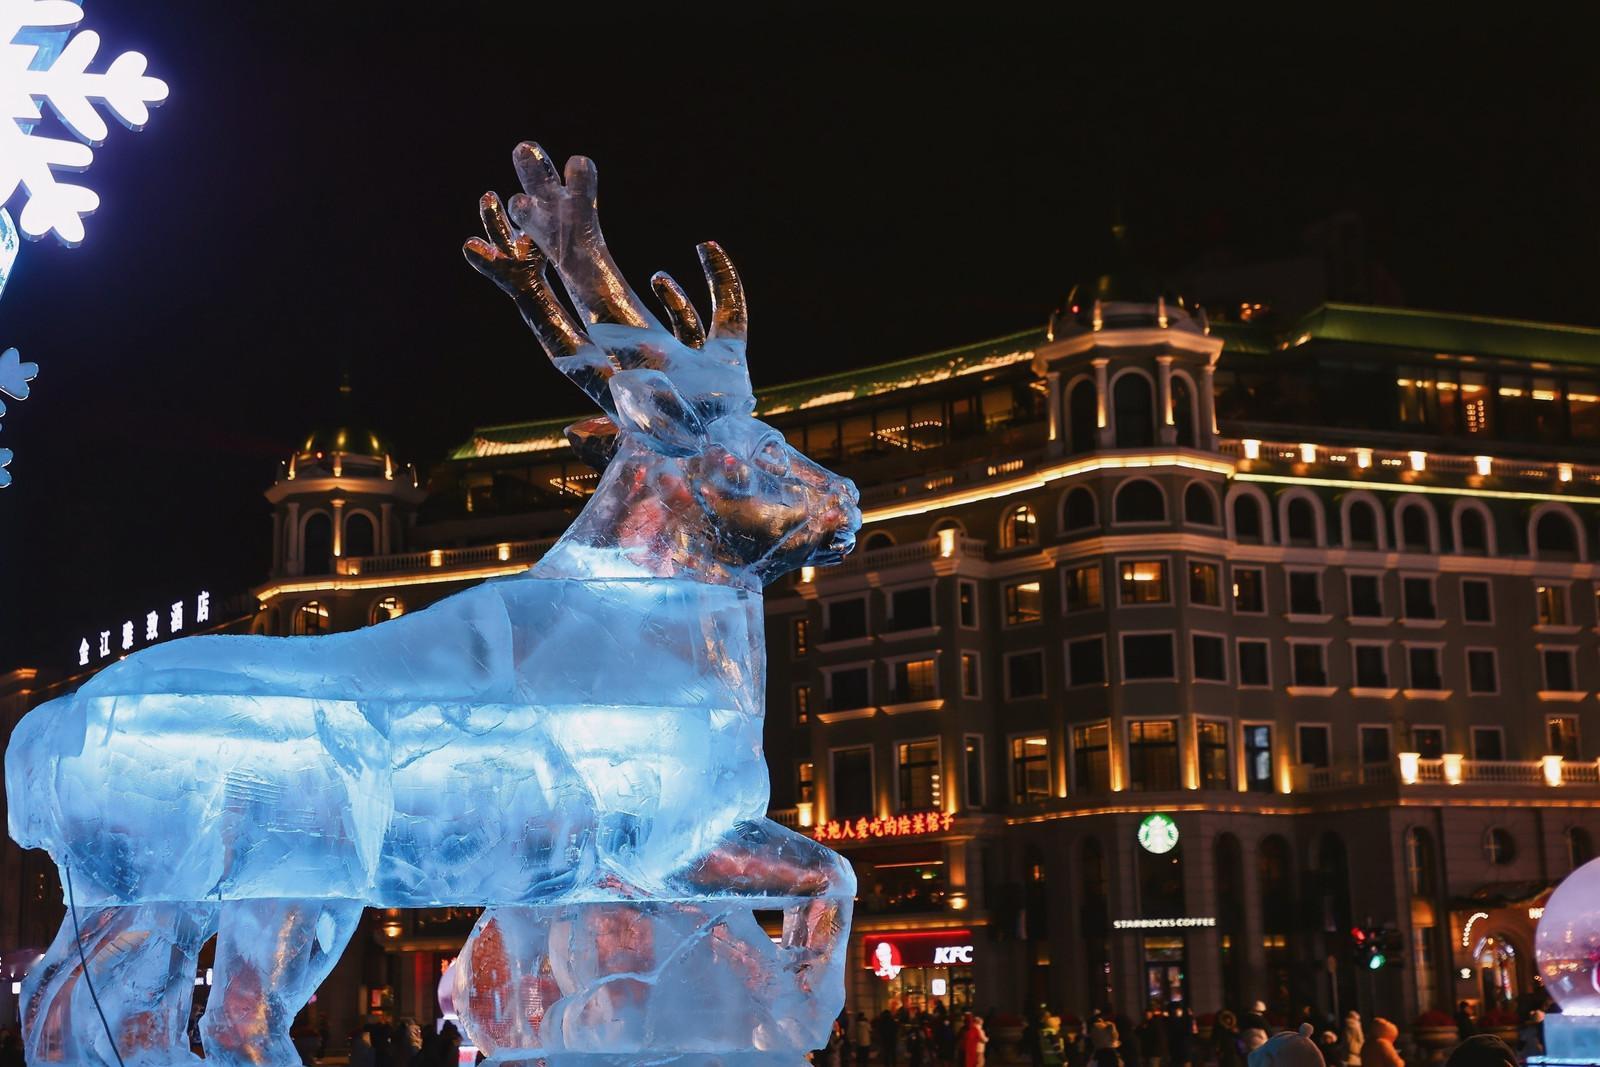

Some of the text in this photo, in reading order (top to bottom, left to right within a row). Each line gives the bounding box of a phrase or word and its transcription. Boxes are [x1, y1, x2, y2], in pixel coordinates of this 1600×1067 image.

[1113, 917, 1216, 929] STARBUCKS COFFEE
[933, 945, 974, 964] KFC
